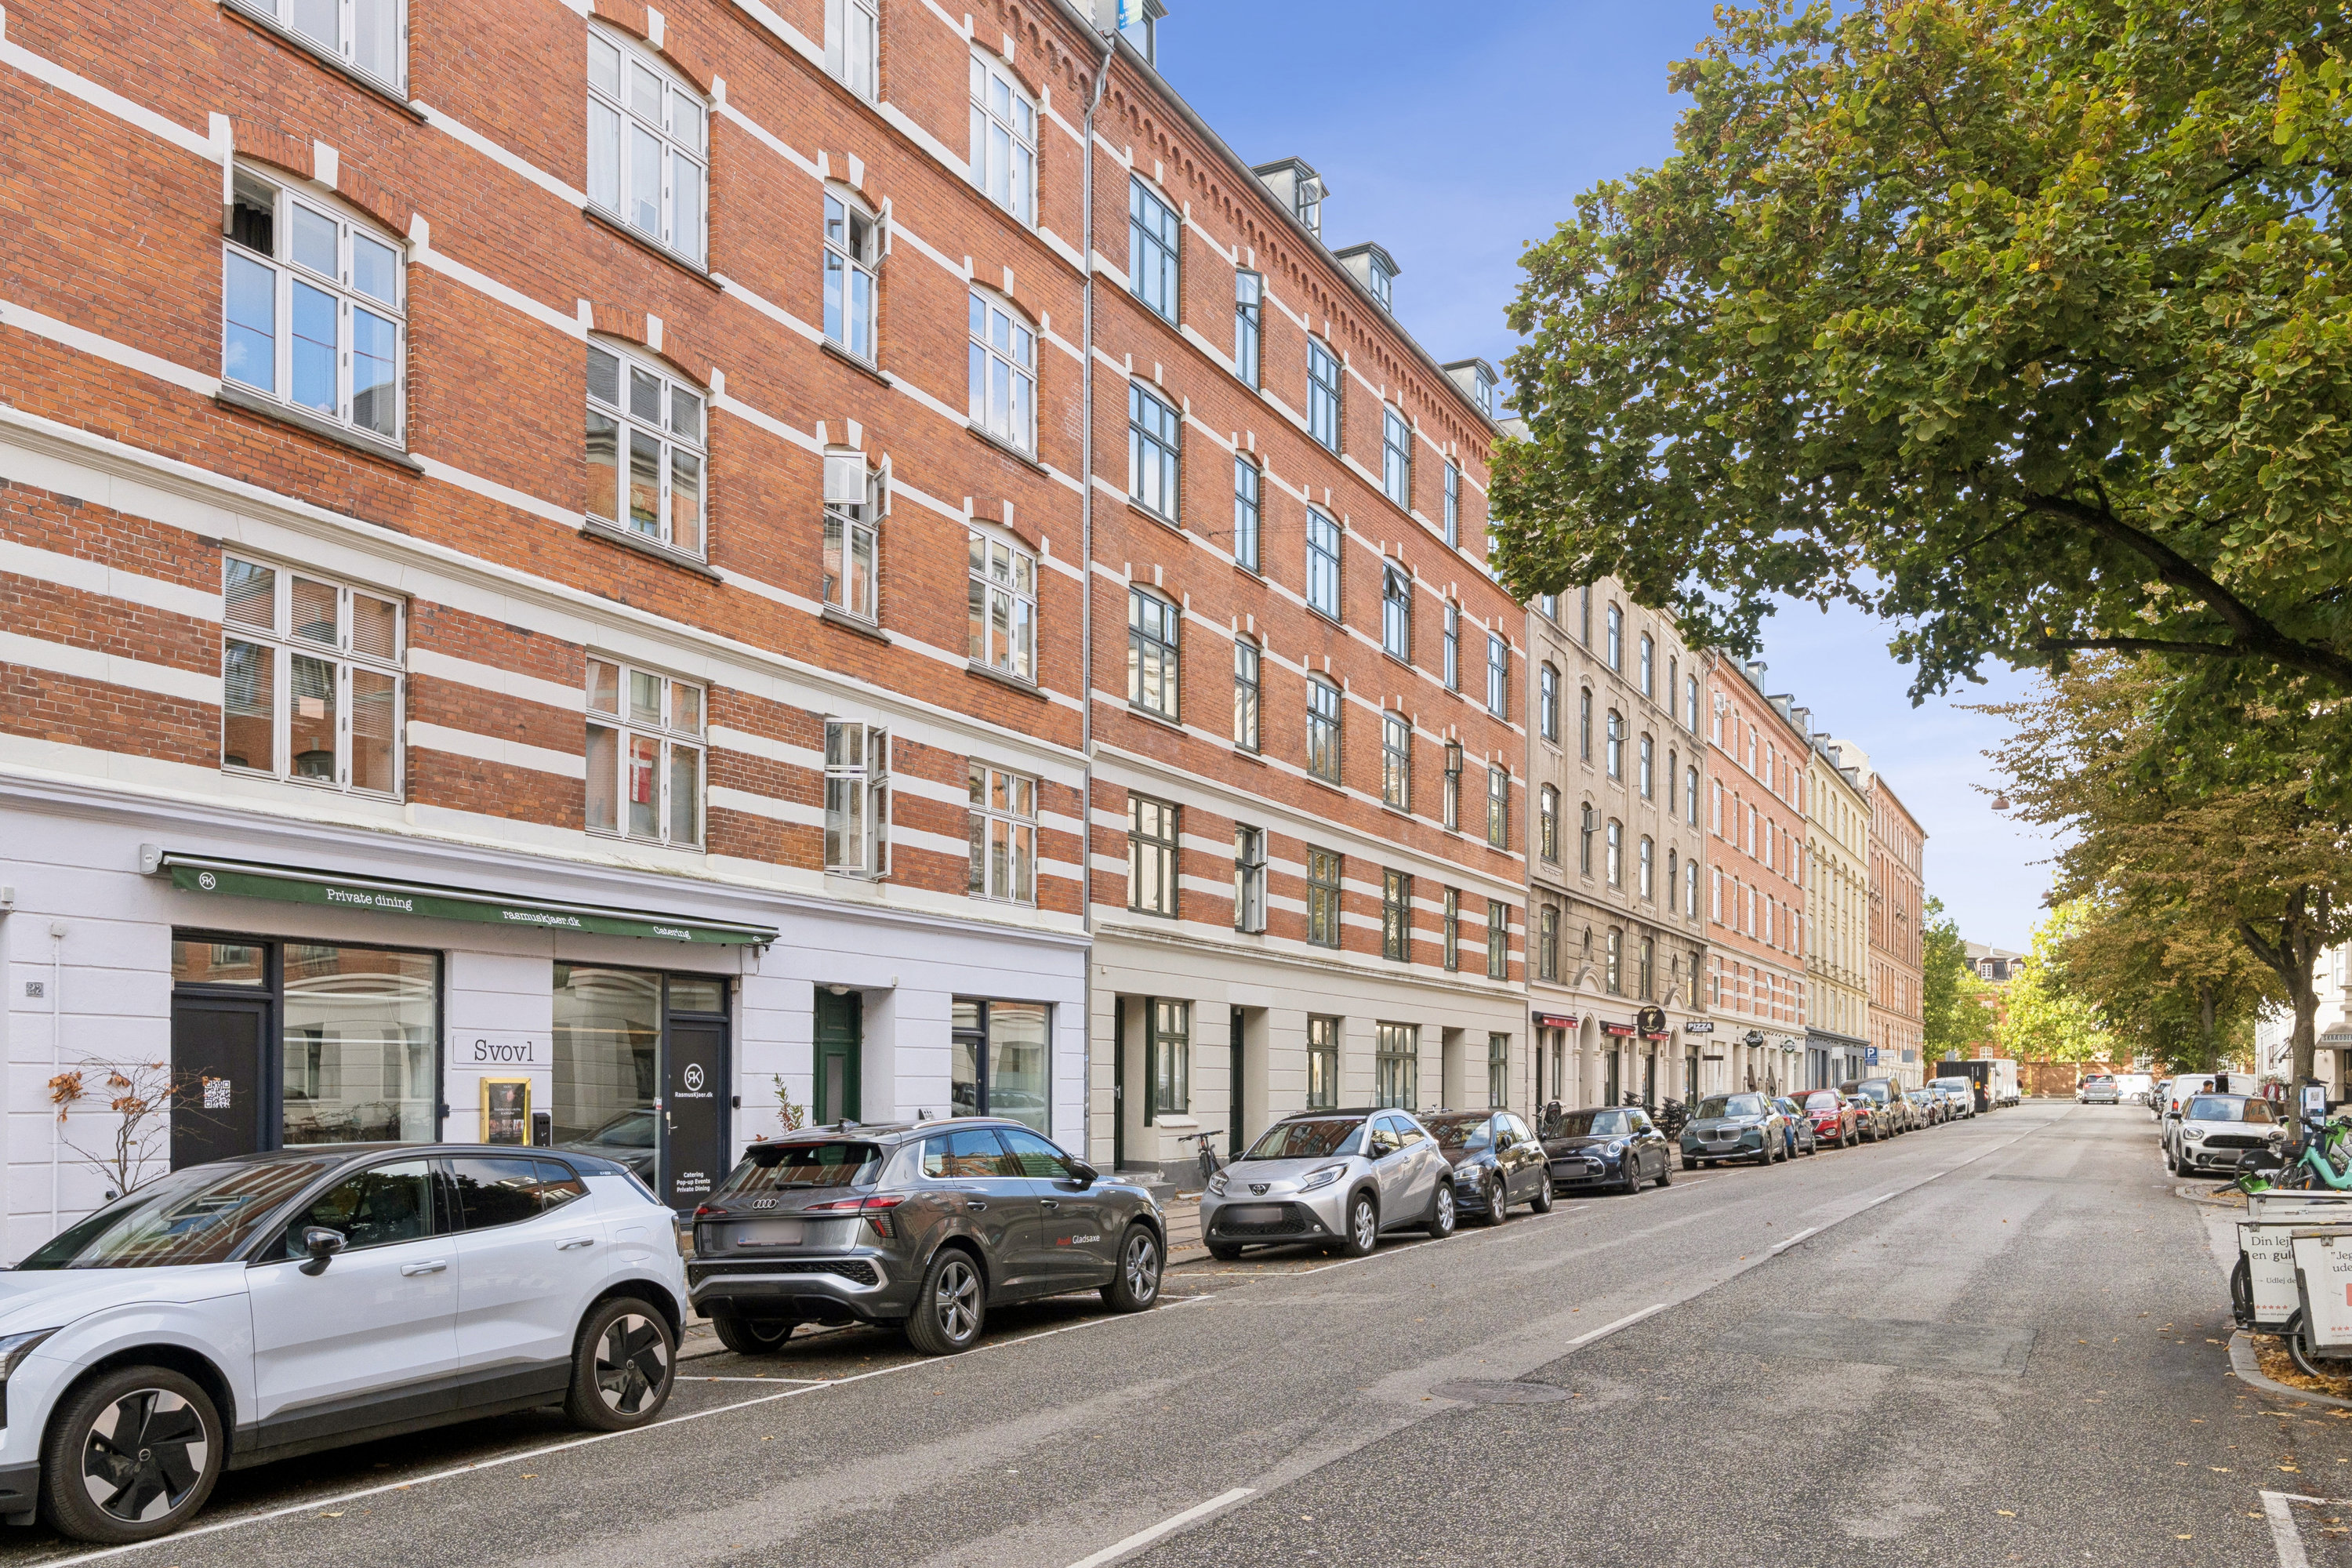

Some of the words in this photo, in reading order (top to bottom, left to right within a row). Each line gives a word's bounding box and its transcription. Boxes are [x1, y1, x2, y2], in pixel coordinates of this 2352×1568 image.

[326, 888, 372, 904] Private
[375, 895, 412, 911] dining
[503, 911, 581, 927] rasmuskjaer.dk
[653, 926, 691, 939] Catering
[474, 1039, 534, 1062] Svovl
[1867, 1048, 1875, 1058] P
[1073, 1235, 1100, 1244] Gladsaxe
[2252, 1236, 2273, 1246] Din
